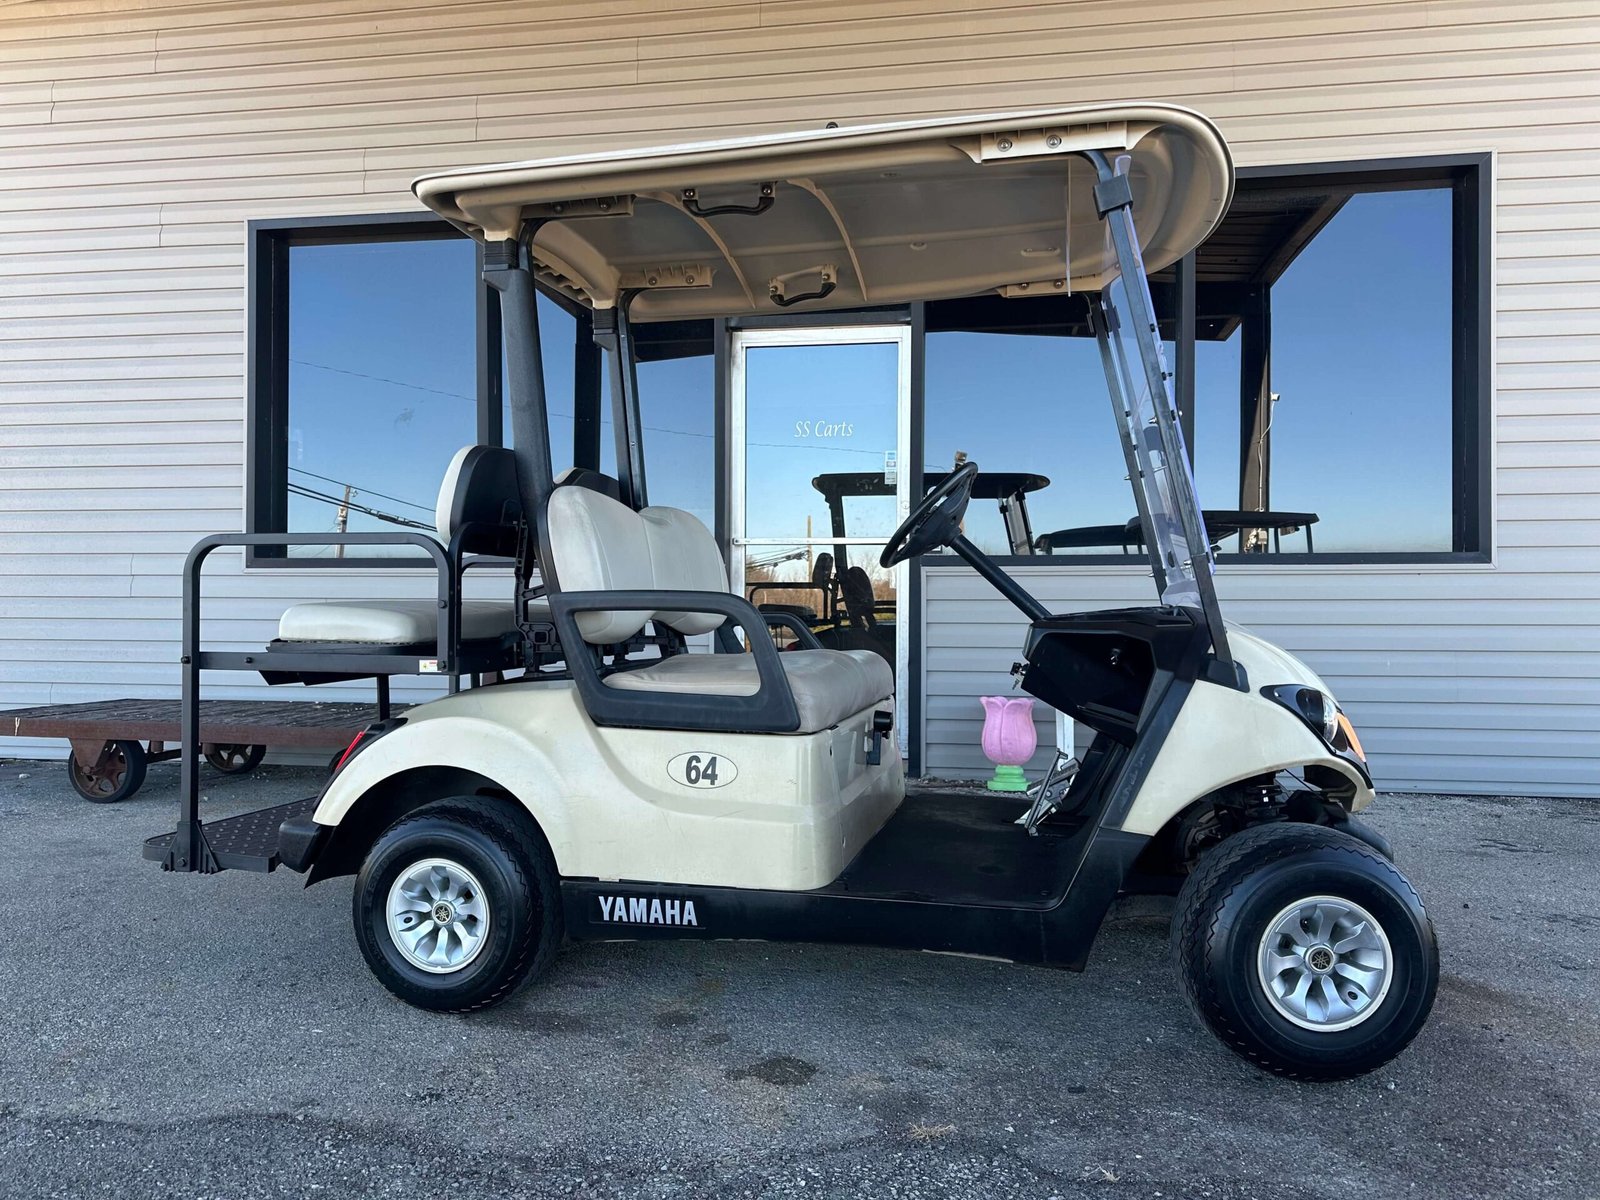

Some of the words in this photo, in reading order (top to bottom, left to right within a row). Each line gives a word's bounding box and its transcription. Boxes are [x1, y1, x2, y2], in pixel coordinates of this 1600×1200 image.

[794, 420, 811, 438] SS
[815, 420, 854, 437] Carts
[685, 755, 718, 786] 64
[598, 895, 698, 926] YAMAHA
